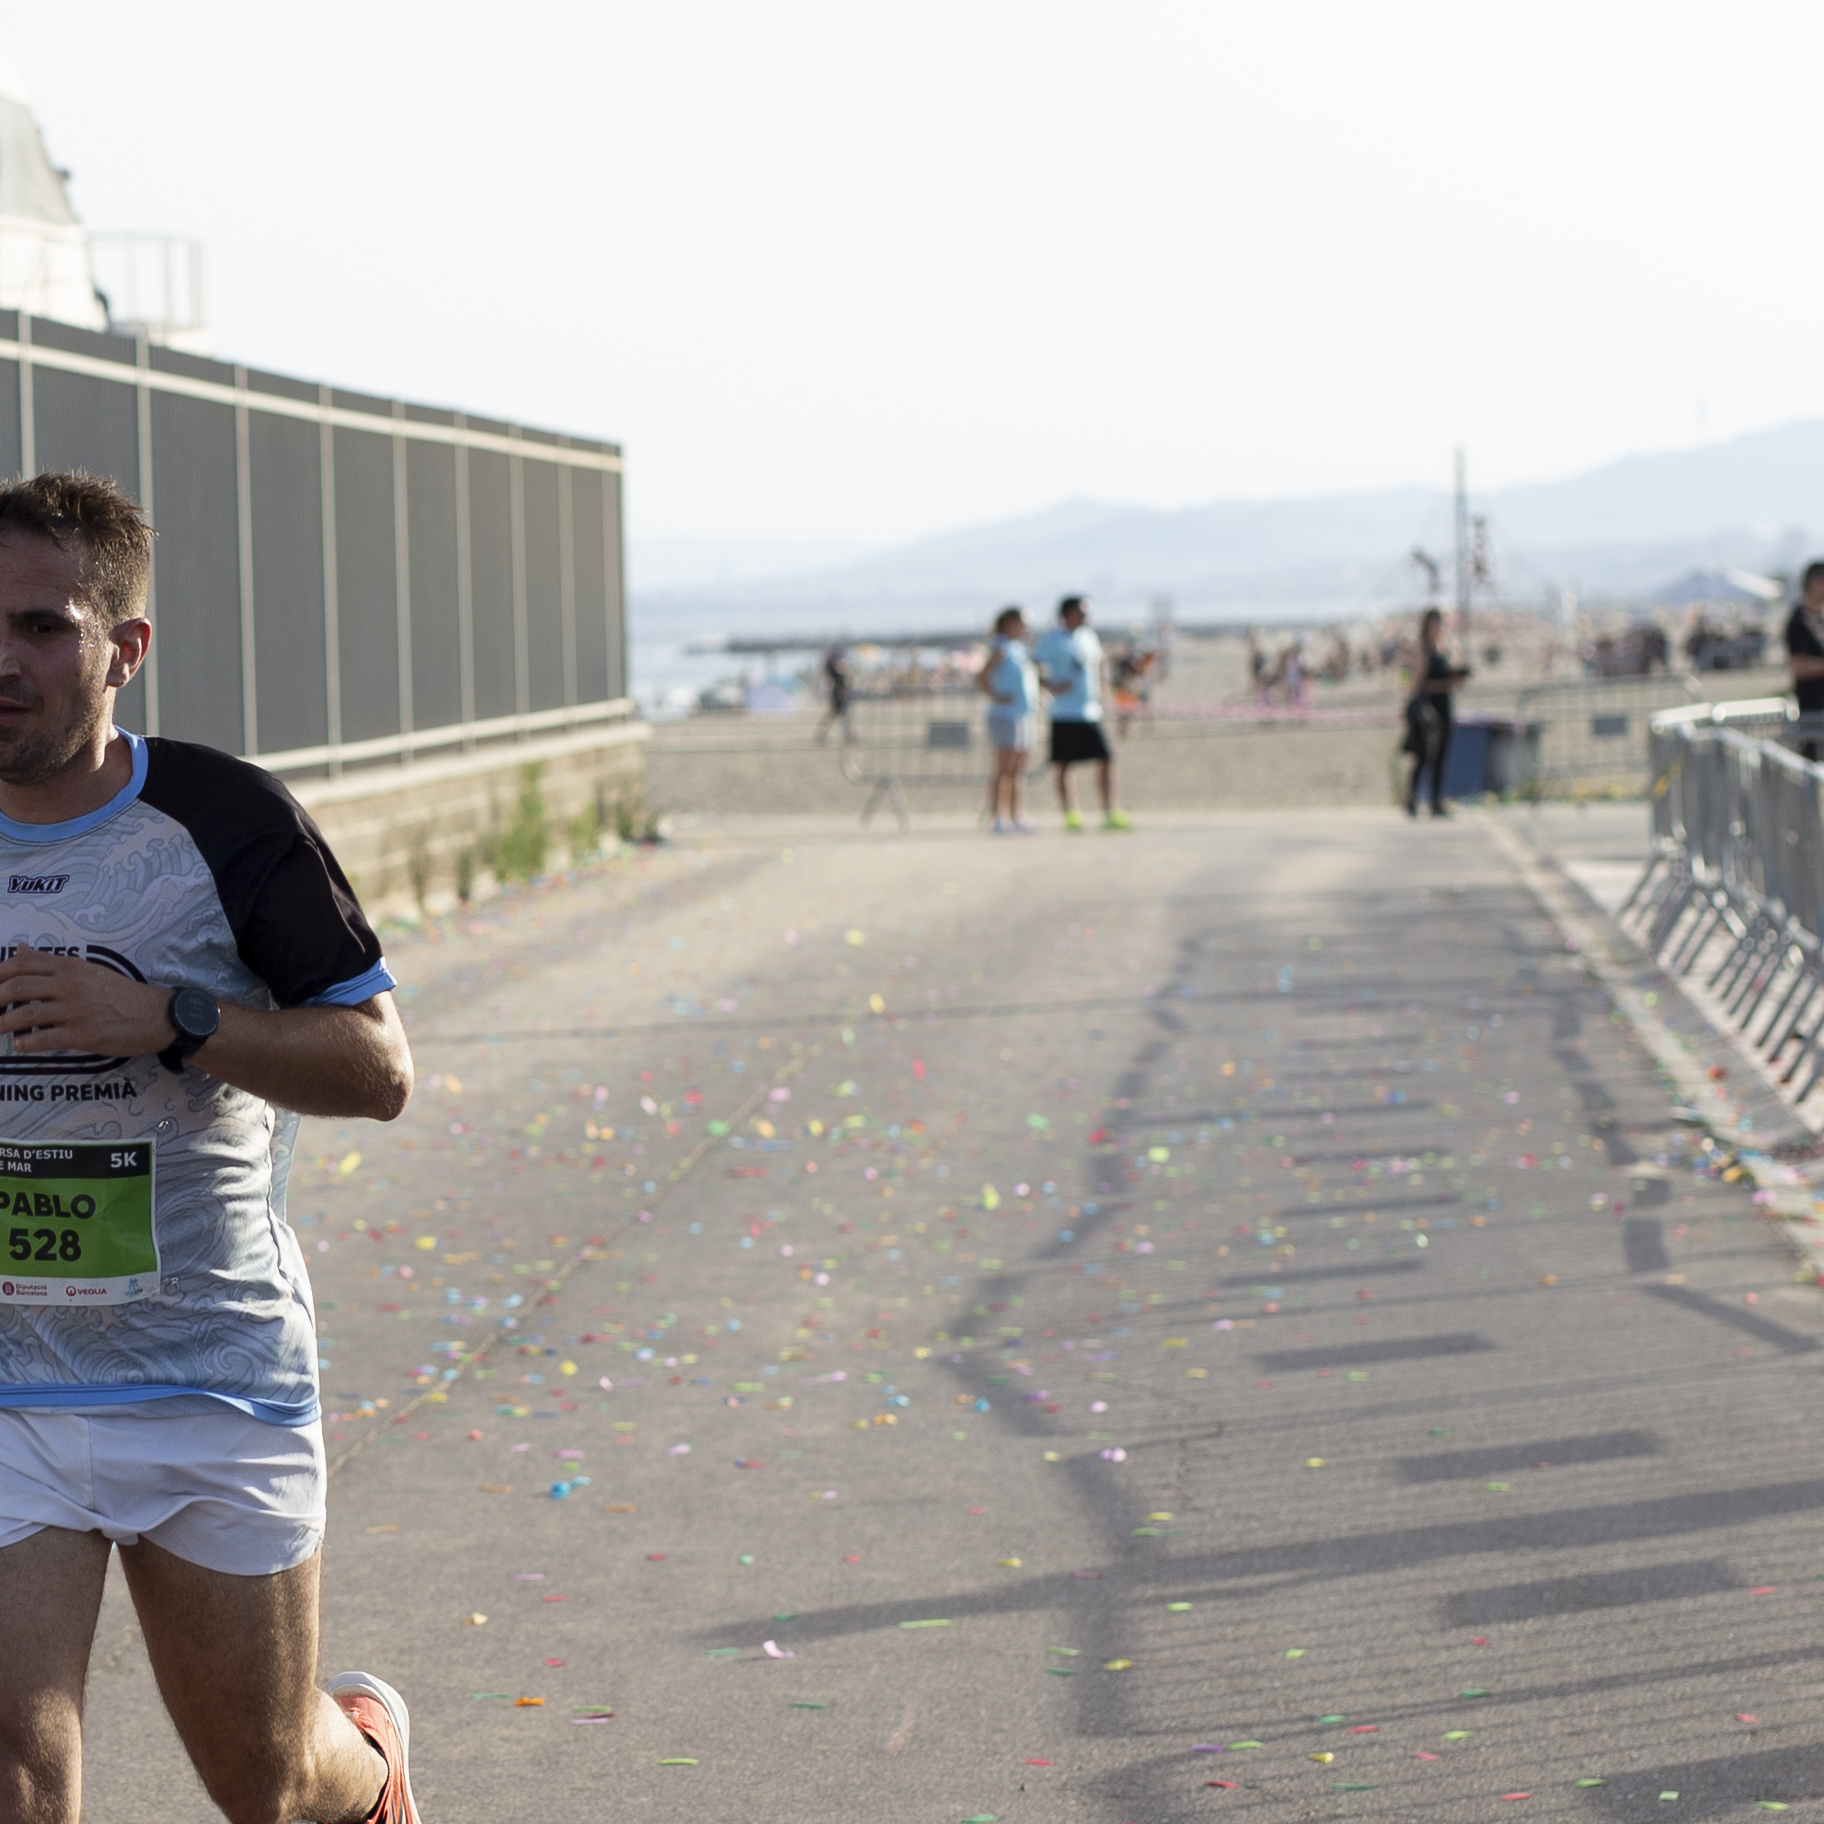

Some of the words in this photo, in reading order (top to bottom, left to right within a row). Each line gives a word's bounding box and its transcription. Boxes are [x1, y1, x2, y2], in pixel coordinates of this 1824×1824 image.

[51, 1077, 137, 1102] PREMIÀ
[7, 1161, 32, 1173] MAR
[110, 1152, 137, 1168] 5K
[8, 1228, 82, 1262] 528
